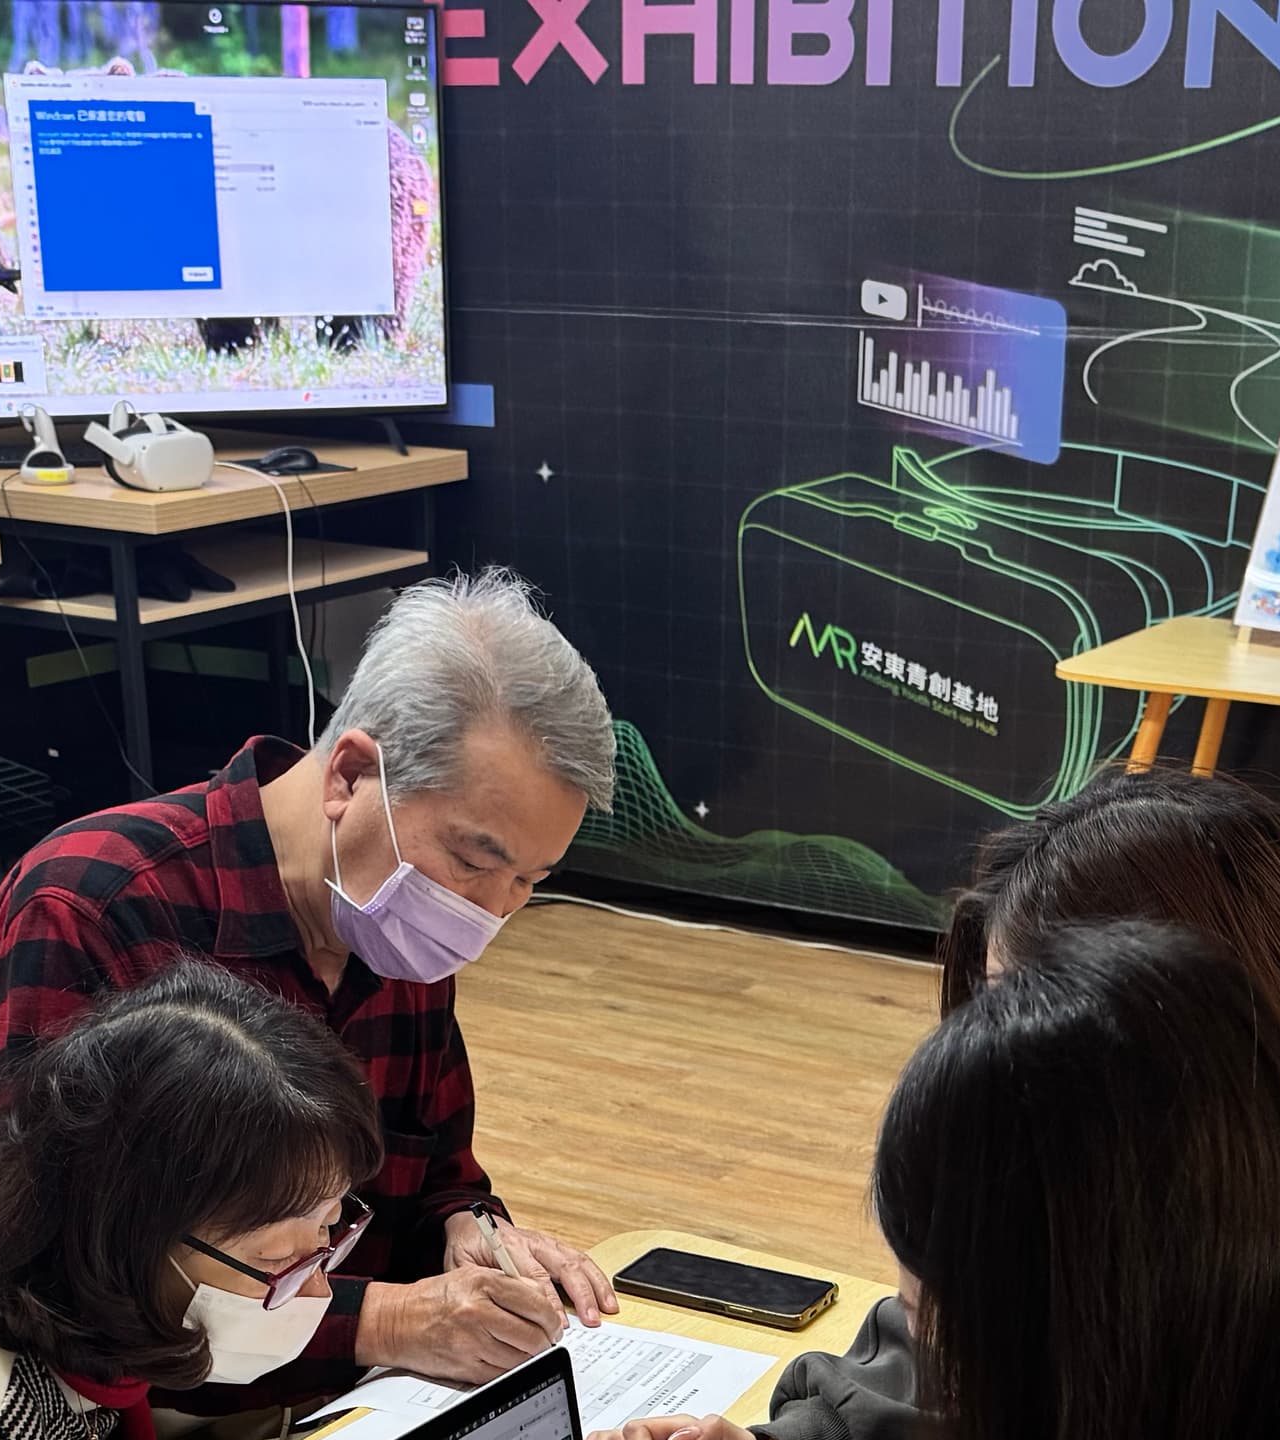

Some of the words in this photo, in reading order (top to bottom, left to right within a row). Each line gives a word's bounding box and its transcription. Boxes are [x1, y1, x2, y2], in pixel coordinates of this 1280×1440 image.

[861, 640, 1000, 723] 安東青創基地
